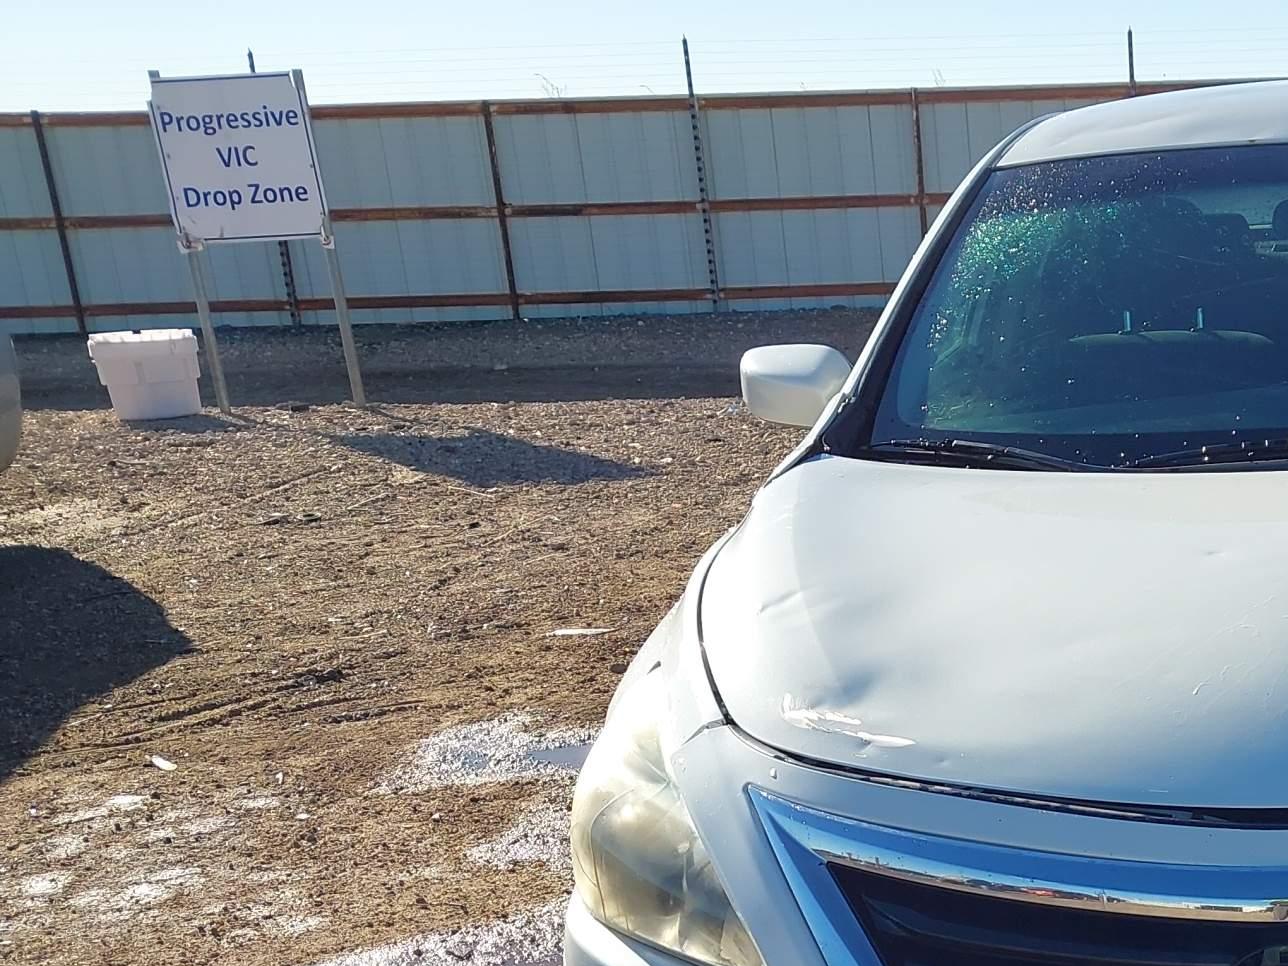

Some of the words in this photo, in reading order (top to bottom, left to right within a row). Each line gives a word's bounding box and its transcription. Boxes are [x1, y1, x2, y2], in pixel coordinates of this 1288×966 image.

[160, 105, 299, 136] Progressive
[216, 145, 258, 168] VIC
[183, 187, 242, 210] Drop
[247, 184, 309, 204] Zone
